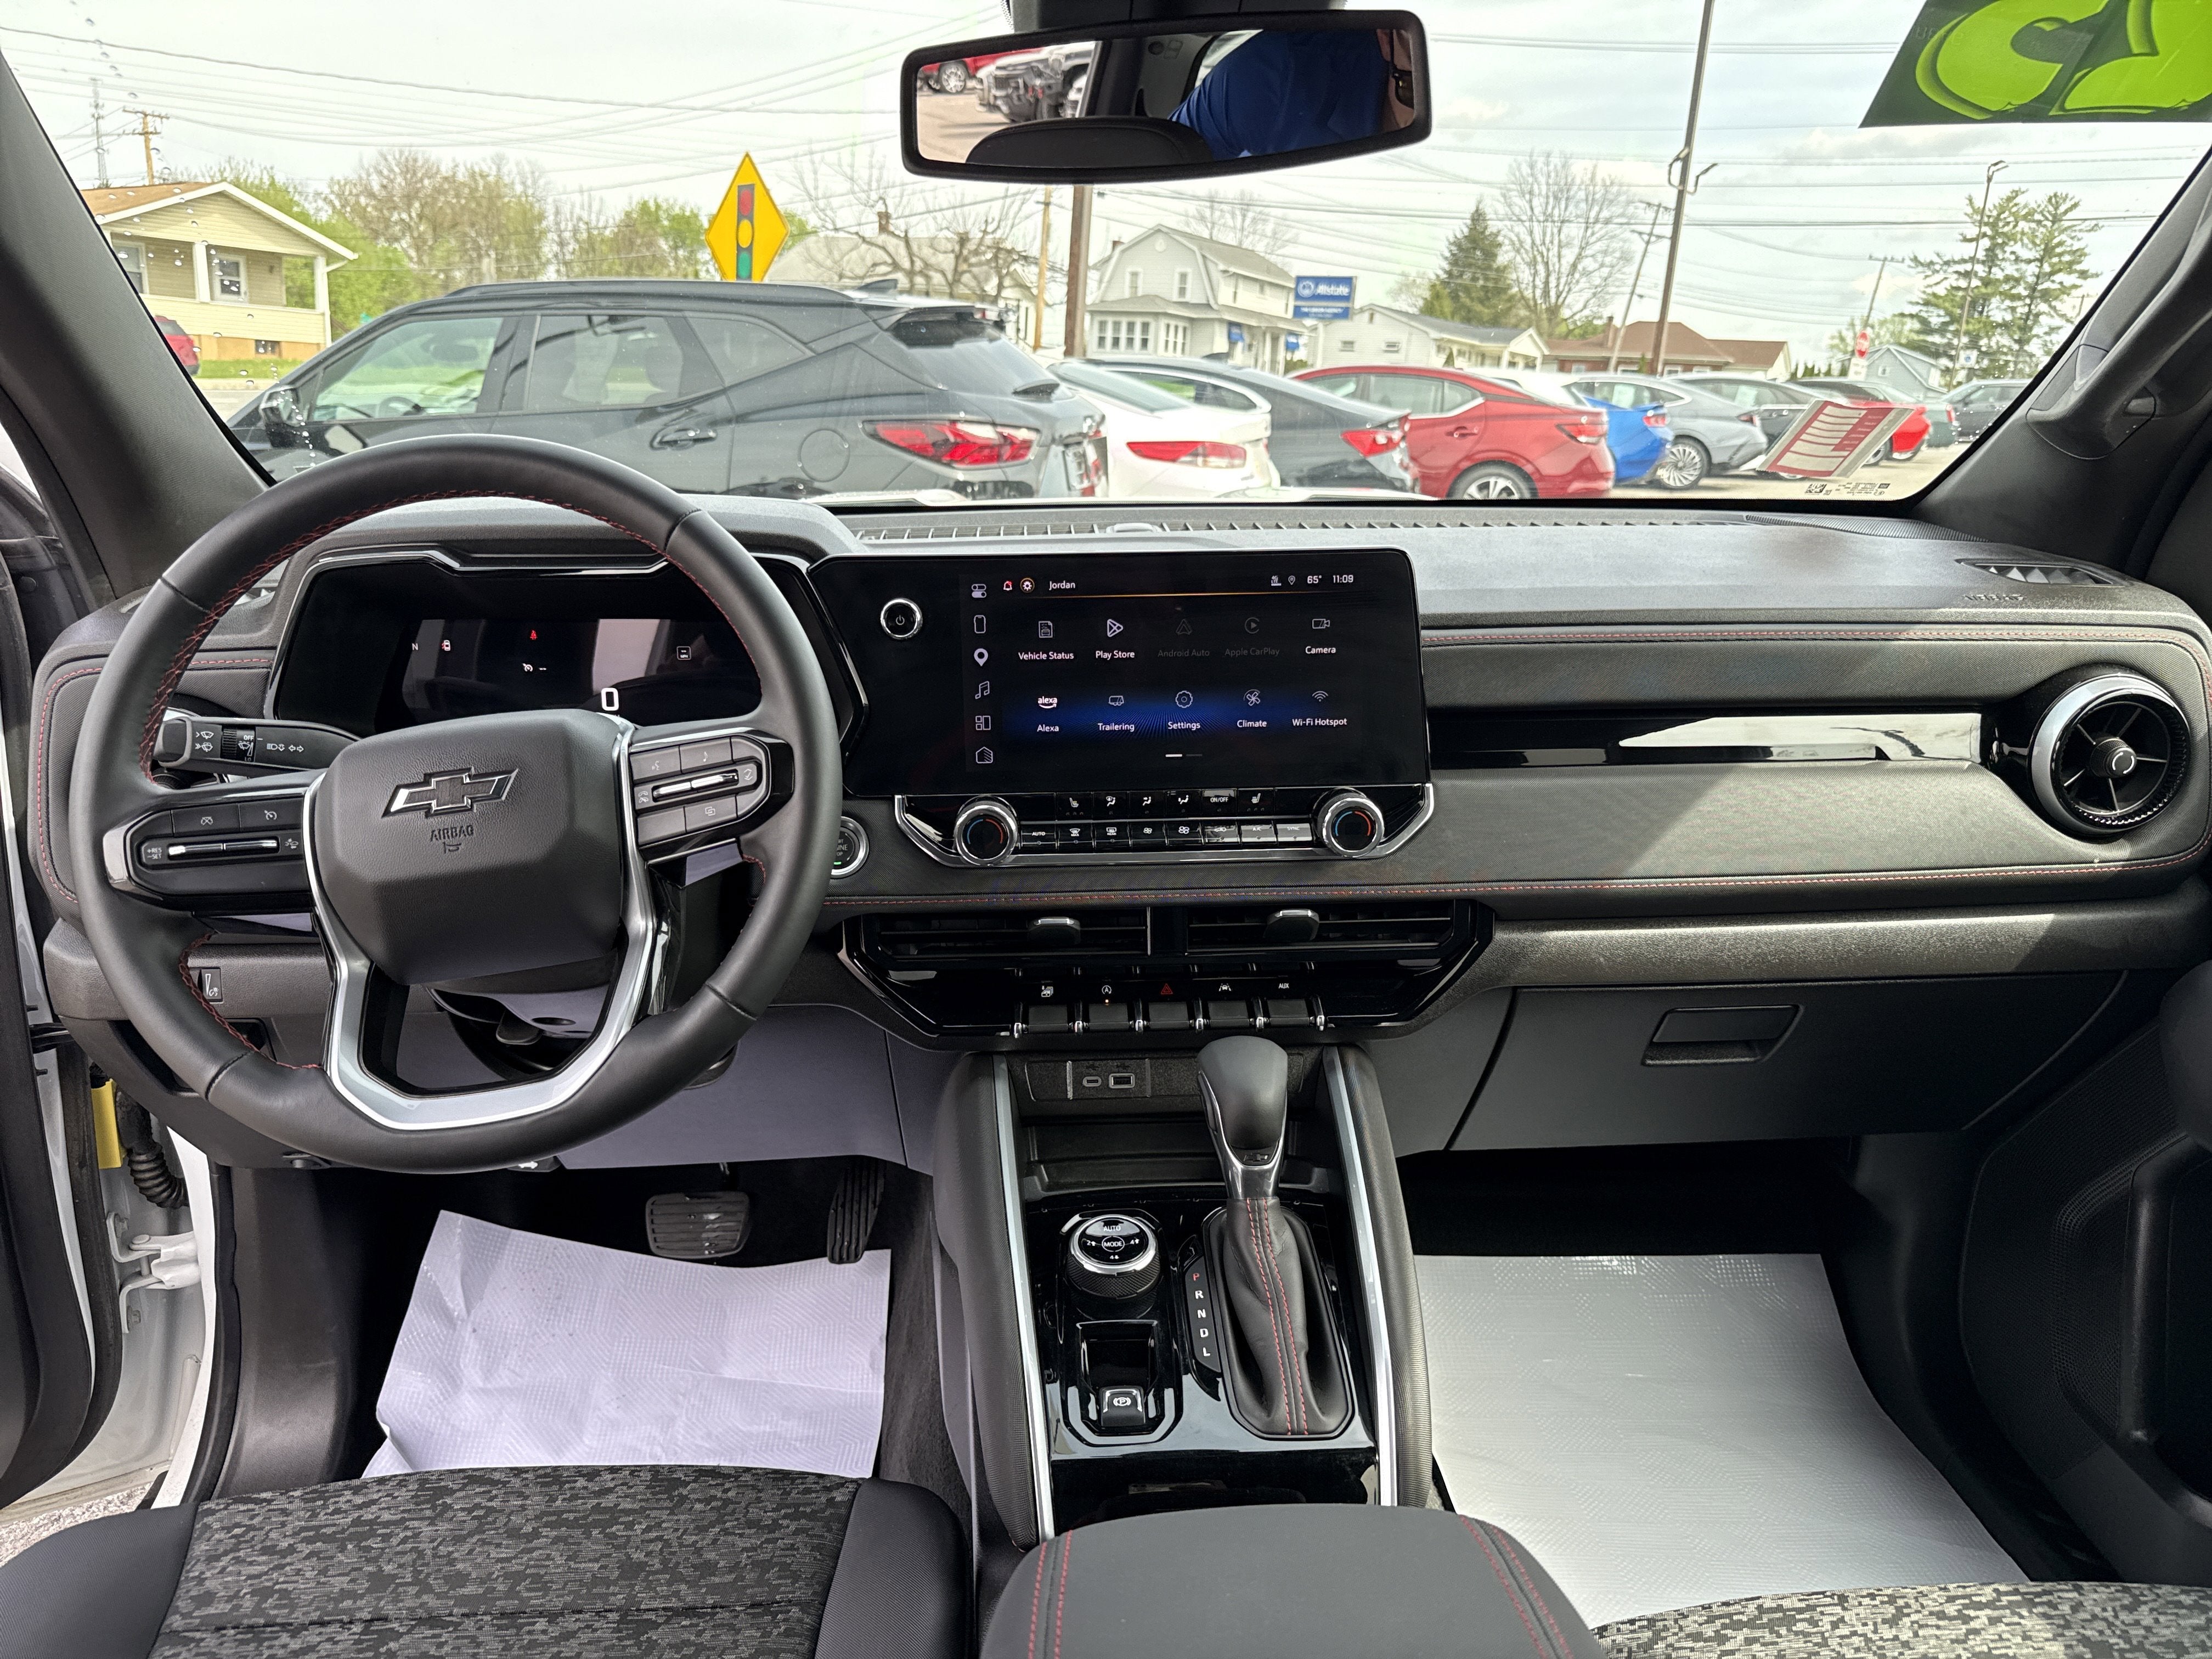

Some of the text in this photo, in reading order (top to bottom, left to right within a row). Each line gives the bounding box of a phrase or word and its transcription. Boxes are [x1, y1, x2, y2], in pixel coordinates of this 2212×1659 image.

[1333, 574, 1353, 583] 11:09
[1049, 580, 1075, 590] Jordan
[1158, 648, 1210, 658] Android Auto
[1224, 647, 1280, 657] Apple CarPlay
[1305, 646, 1336, 654] Camera
[1018, 651, 1074, 661] Vehicle Status
[1096, 651, 1135, 661] Play Store
[601, 687, 619, 711] 0
[1037, 696, 1058, 704] alexa
[1167, 721, 1201, 731] Settings
[1237, 720, 1267, 728] Climate
[1292, 718, 1347, 726] Wi-Fi Hotspot
[1036, 724, 1059, 732] Alexa
[1098, 723, 1135, 732] Trailering
[430, 824, 475, 842] AIRBAG
[1192, 1273, 1200, 1281] P
[1195, 1290, 1204, 1299] R
[1197, 1309, 1206, 1318] N
[1200, 1328, 1209, 1338] D
[1203, 1347, 1211, 1357] L
